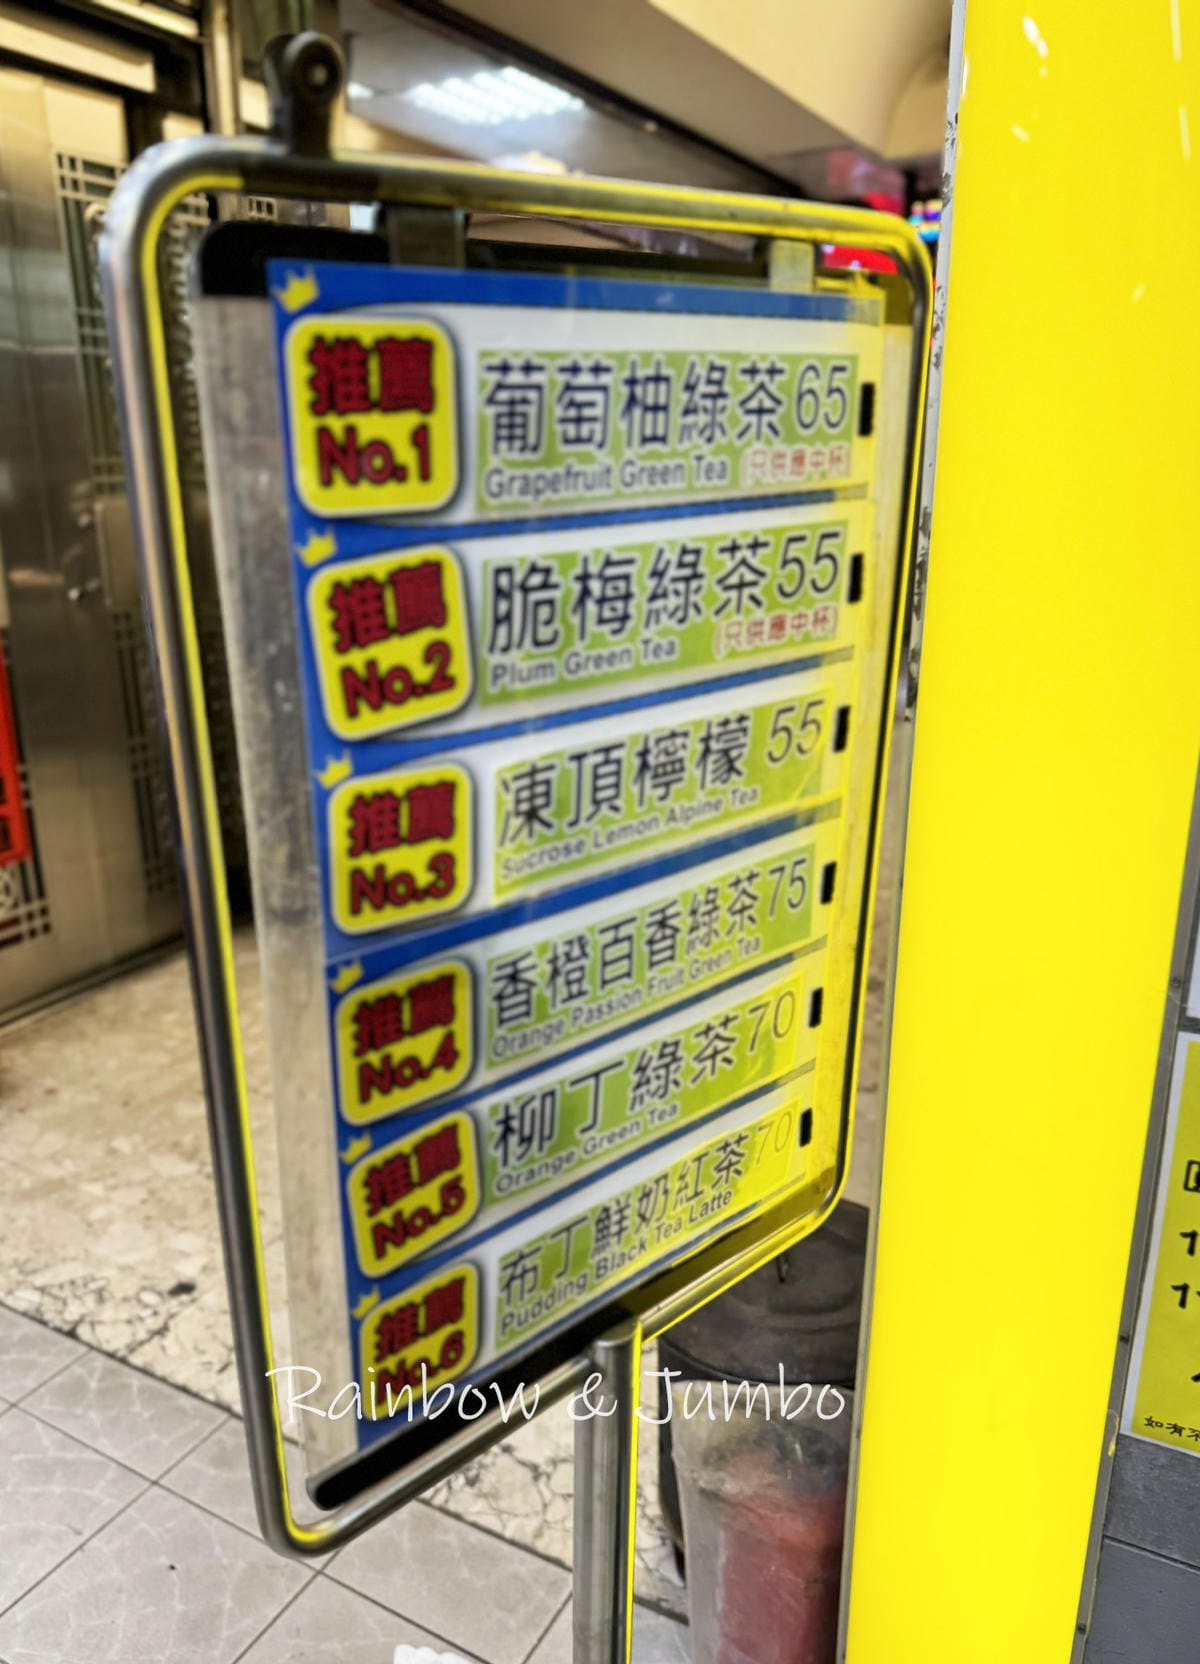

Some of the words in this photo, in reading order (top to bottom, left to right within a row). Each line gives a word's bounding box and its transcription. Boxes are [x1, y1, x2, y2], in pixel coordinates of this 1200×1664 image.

[484, 358, 785, 456] 葡萄柚綠茶
[796, 363, 848, 430] 65
[316, 423, 432, 488] No.1
[485, 462, 612, 501] Grapefruit
[619, 460, 686, 488] Green
[693, 454, 729, 485] Tea
[488, 535, 771, 654] 脆梅綠茶
[776, 531, 841, 599] 55
[339, 640, 456, 719] No.2
[490, 660, 556, 689] Plum
[563, 648, 633, 676] Green
[640, 638, 677, 661] Tea
[499, 714, 751, 848] 凍頂檸檬
[767, 699, 825, 764] 55
[502, 838, 586, 880] Sucrose
[592, 816, 660, 849] Lemon
[664, 797, 723, 827] Alpine
[730, 786, 759, 807] Tea
[349, 850, 456, 916] No.3
[491, 870, 760, 1029] 香橙百香綠茶
[768, 857, 808, 917] 75
[493, 1018, 565, 1058] Orange
[571, 987, 643, 1026] Passion
[648, 967, 685, 993] Fruit
[689, 949, 733, 979] Green
[737, 936, 761, 957] Tea
[357, 1028, 460, 1105] No.4
[494, 1012, 740, 1168] 柳丁綠茶
[749, 990, 796, 1052] 70
[495, 1149, 576, 1193] Orange
[582, 1120, 642, 1155] Green
[648, 1102, 678, 1124] Tea
[371, 1173, 467, 1262] No.5
[501, 1132, 749, 1306] 布丁鮮奶紅茶
[756, 1110, 793, 1167] 70
[501, 1272, 588, 1337] Pudding
[594, 1239, 647, 1281] Black
[654, 1218, 683, 1243] Tea
[689, 1188, 733, 1223] Latte
[1171, 1282, 1200, 1310] 1
